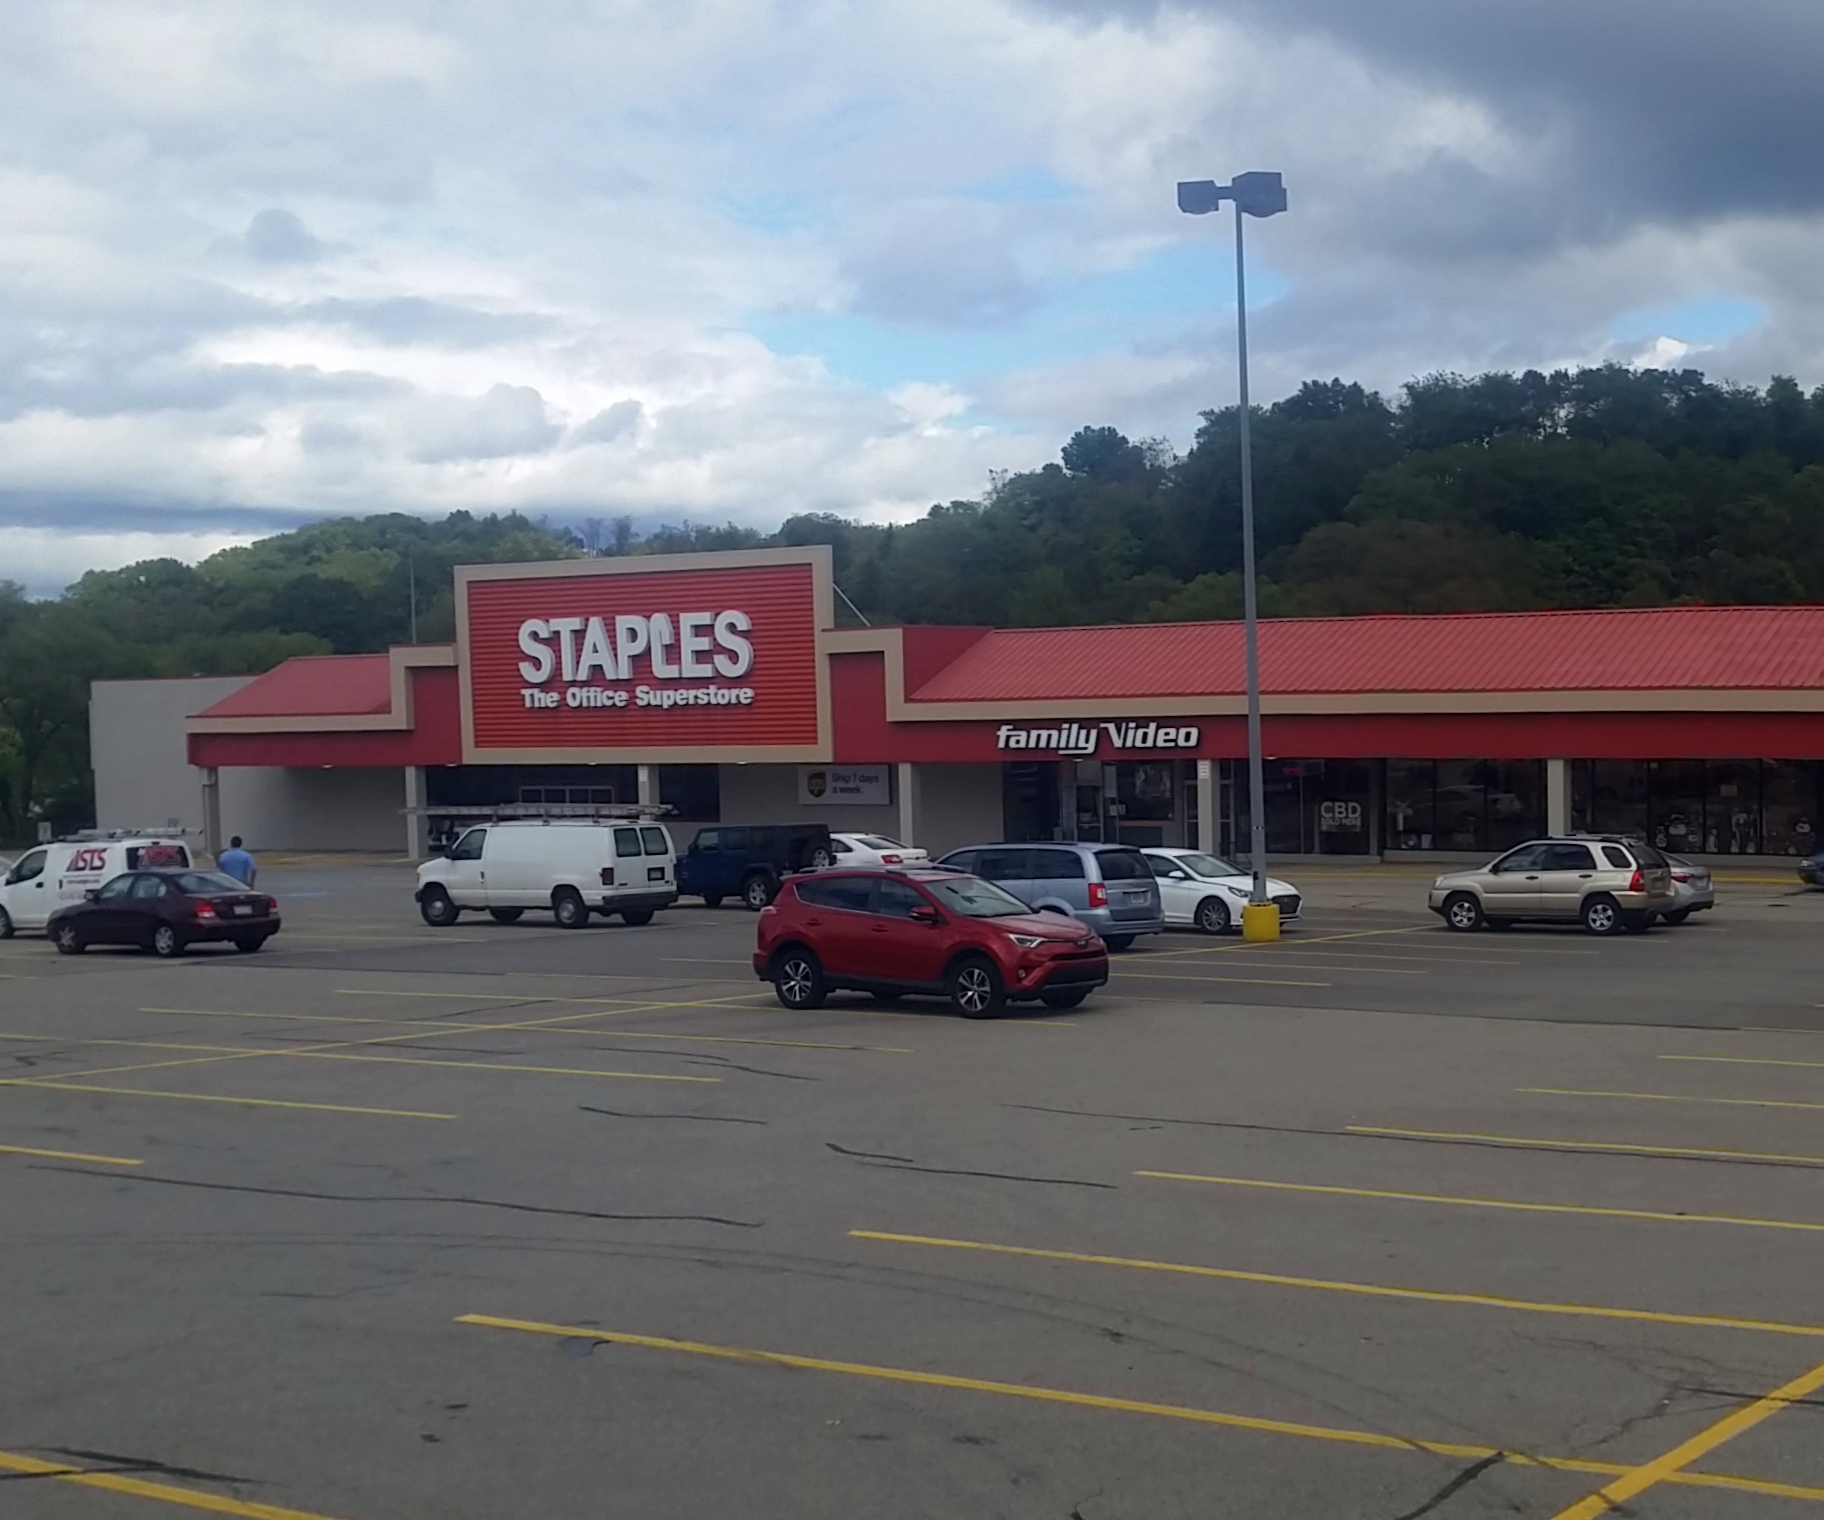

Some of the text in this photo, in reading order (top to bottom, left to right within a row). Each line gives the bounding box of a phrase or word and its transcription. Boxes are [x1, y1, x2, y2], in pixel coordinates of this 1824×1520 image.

[518, 610, 754, 683] STAPLES
[521, 685, 754, 708] The Office Superstore
[996, 721, 1200, 755] family Video
[832, 772, 880, 785] Ship 7 days
[832, 786, 838, 794] a
[1320, 801, 1362, 818] CBD
[1342, 818, 1361, 826] HERE
